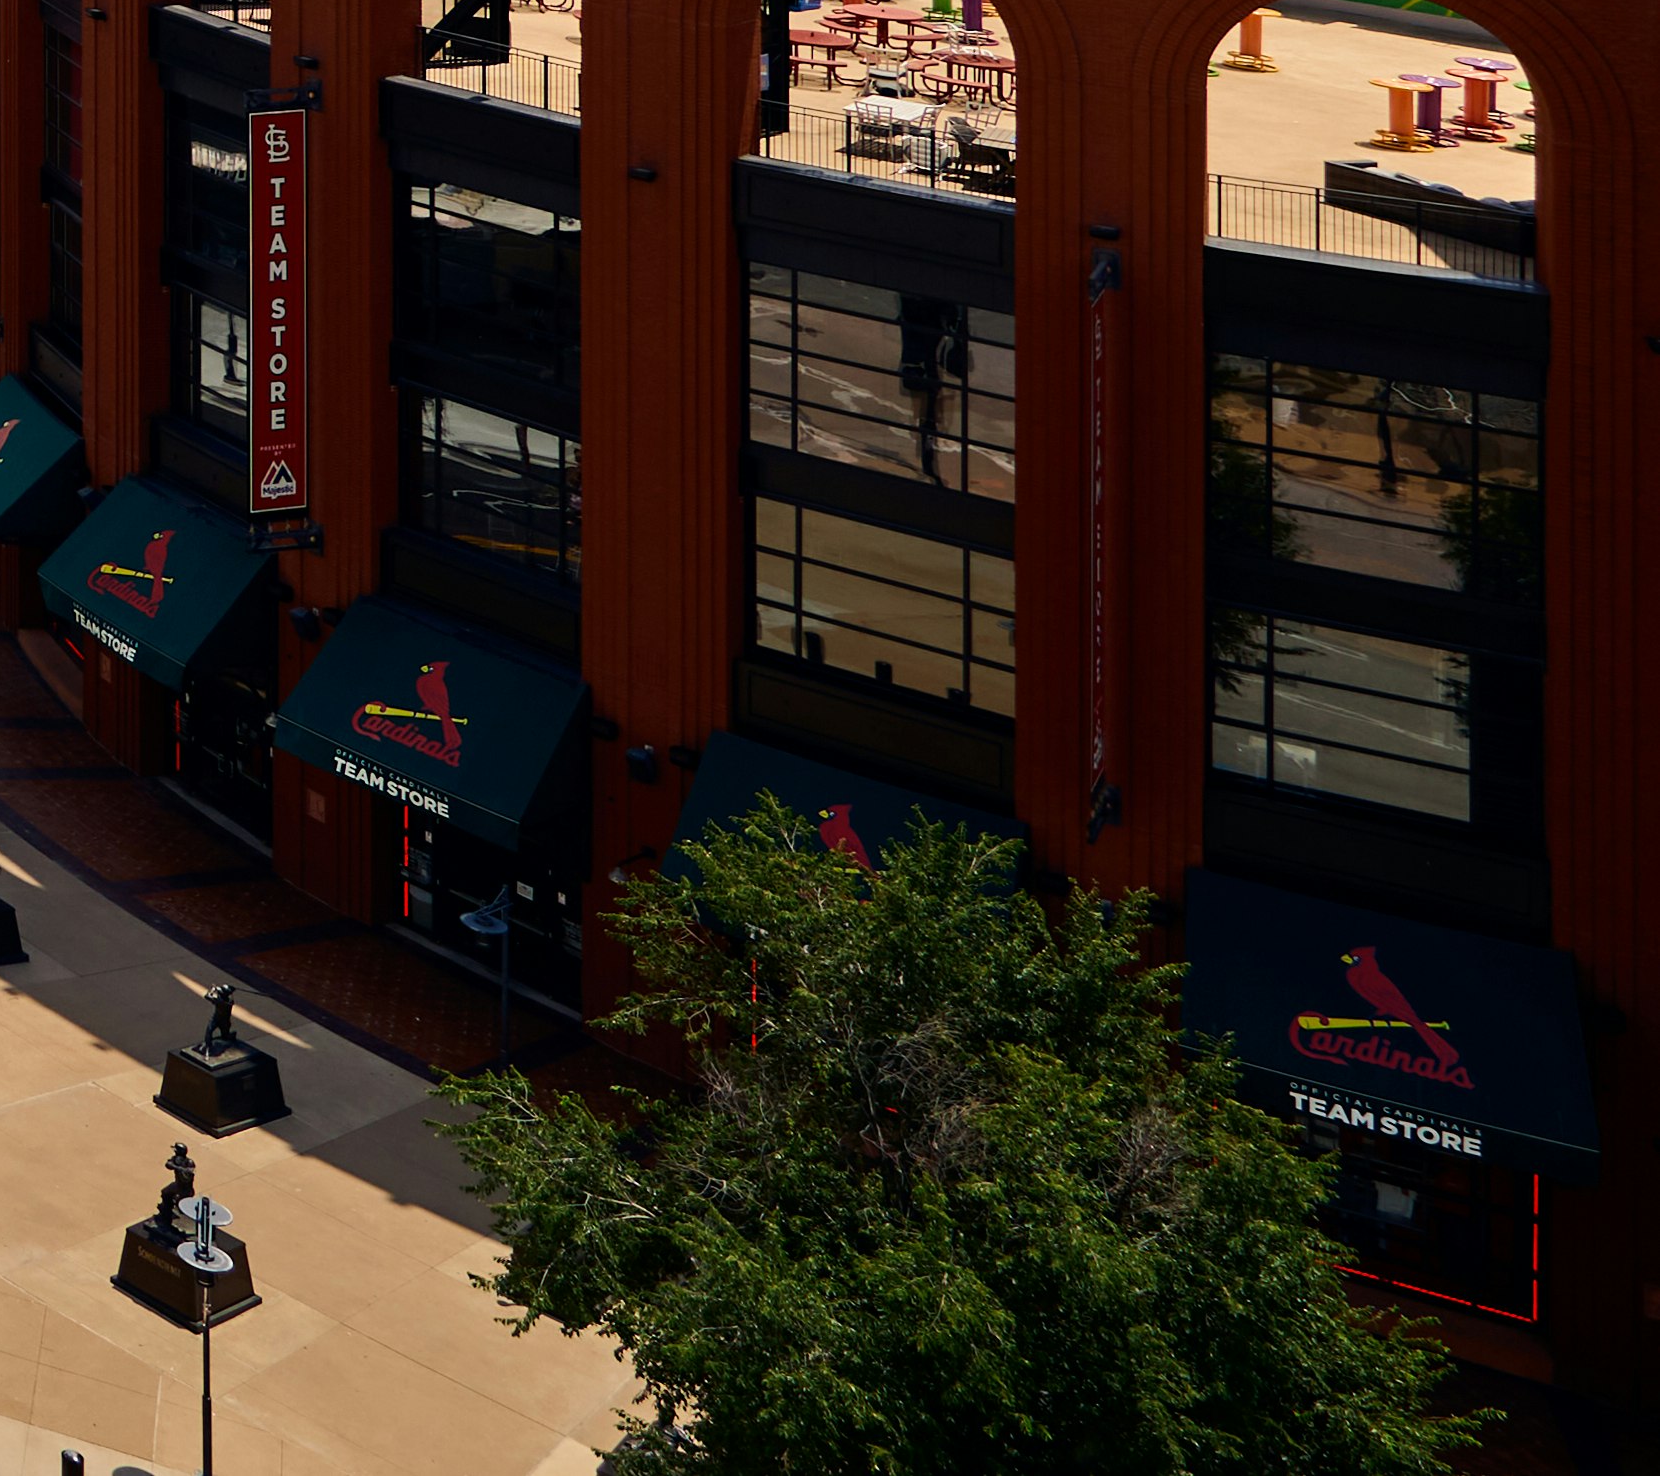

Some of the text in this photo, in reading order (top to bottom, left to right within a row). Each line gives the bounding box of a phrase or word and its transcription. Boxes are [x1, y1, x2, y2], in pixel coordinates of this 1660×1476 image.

[269, 177, 288, 432] TEAM STORE
[262, 485, 294, 499] Majestic
[87, 562, 159, 619] Cardinals
[73, 609, 136, 663] TEAM STORE
[351, 701, 461, 768] Cardinals
[334, 756, 450, 819] TEAM STORE
[336, 749, 449, 802] OFFICIAL CARDINALS
[1289, 1010, 1475, 1090] Cardinals
[1289, 1091, 1483, 1157] TEAM STORE
[1290, 1082, 1482, 1136] OFFICIAL CARDINALS
